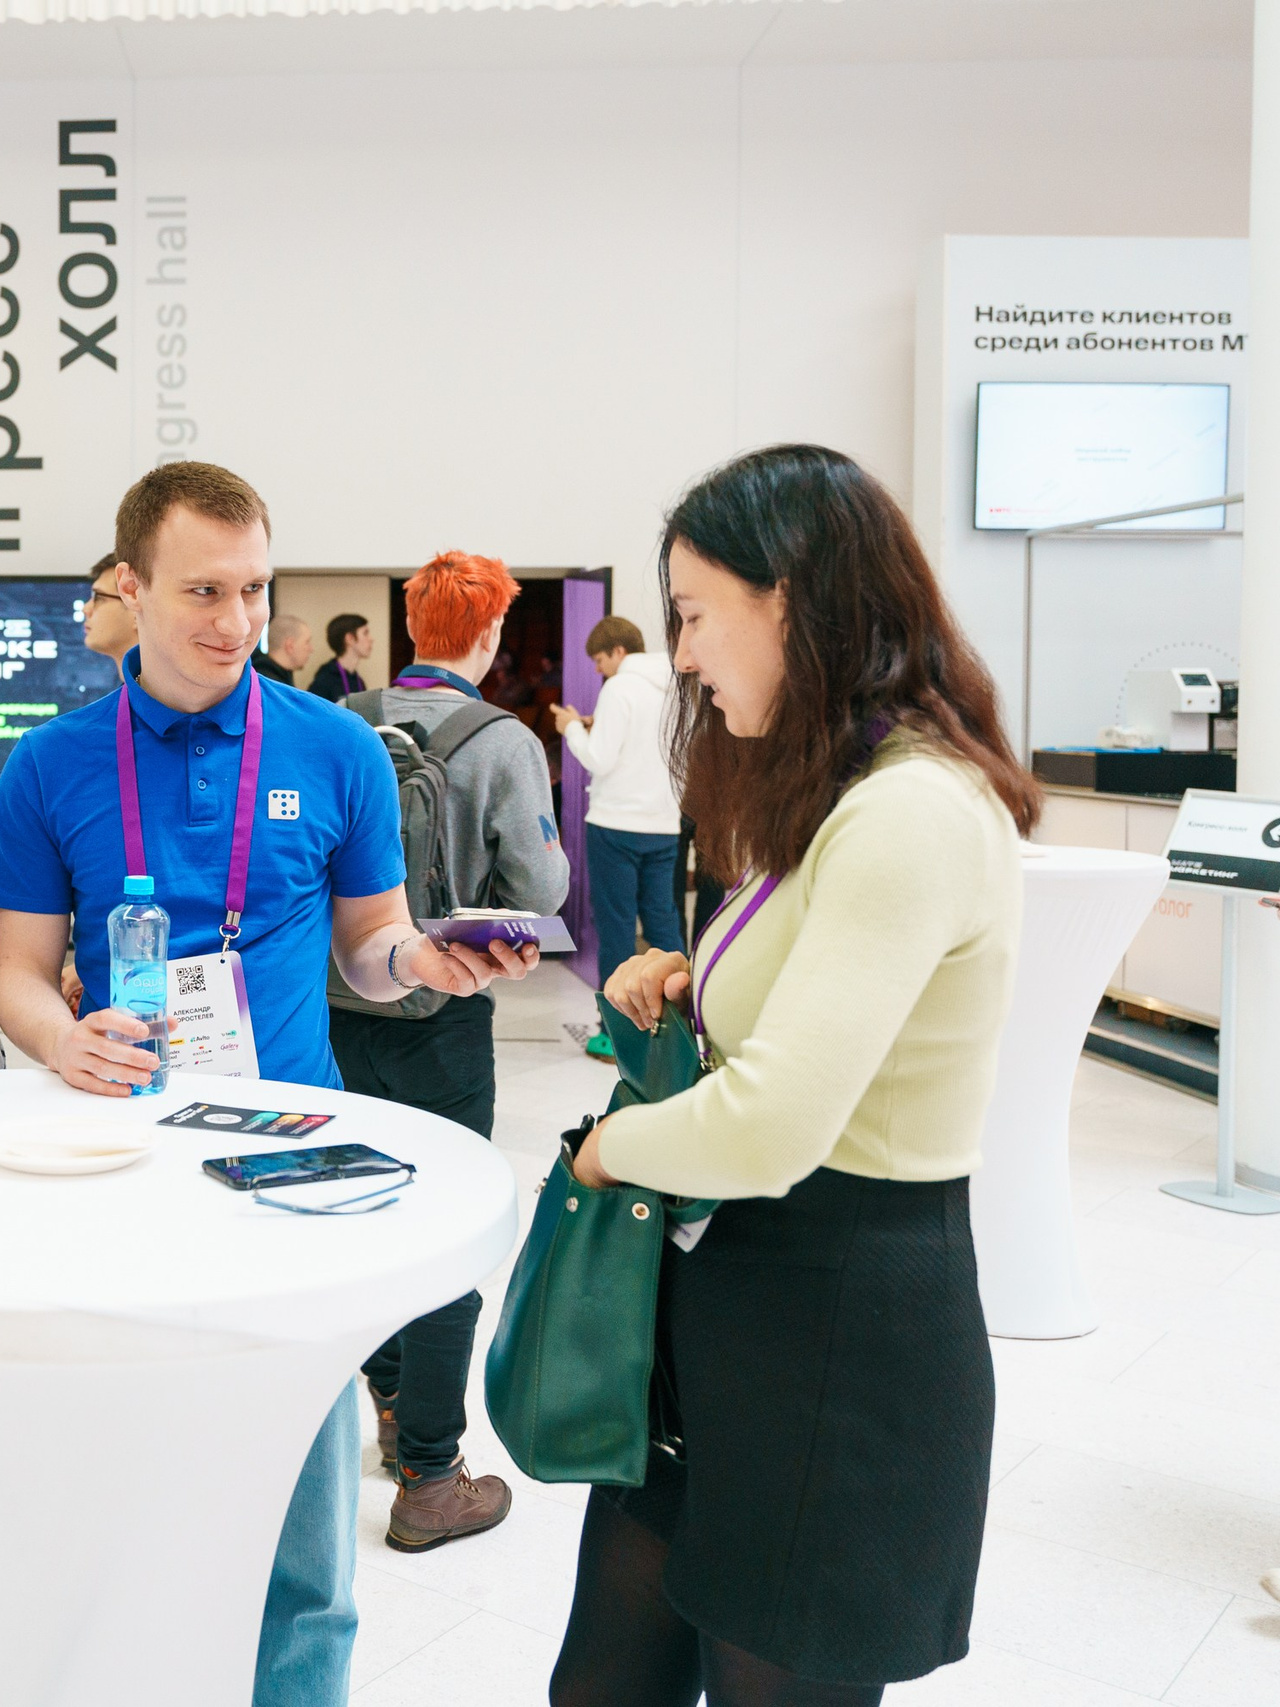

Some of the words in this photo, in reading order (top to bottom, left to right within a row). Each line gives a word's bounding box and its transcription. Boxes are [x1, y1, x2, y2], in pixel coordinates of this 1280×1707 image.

[58, 119, 118, 372] холл
[146, 196, 187, 285] hall
[975, 304, 1095, 326] Найдите
[1102, 309, 1232, 325] клиентов
[974, 334, 1059, 353] среди
[1066, 332, 1214, 351] абонентов
[173, 1006, 211, 1016] АЛЕКСАНДР
